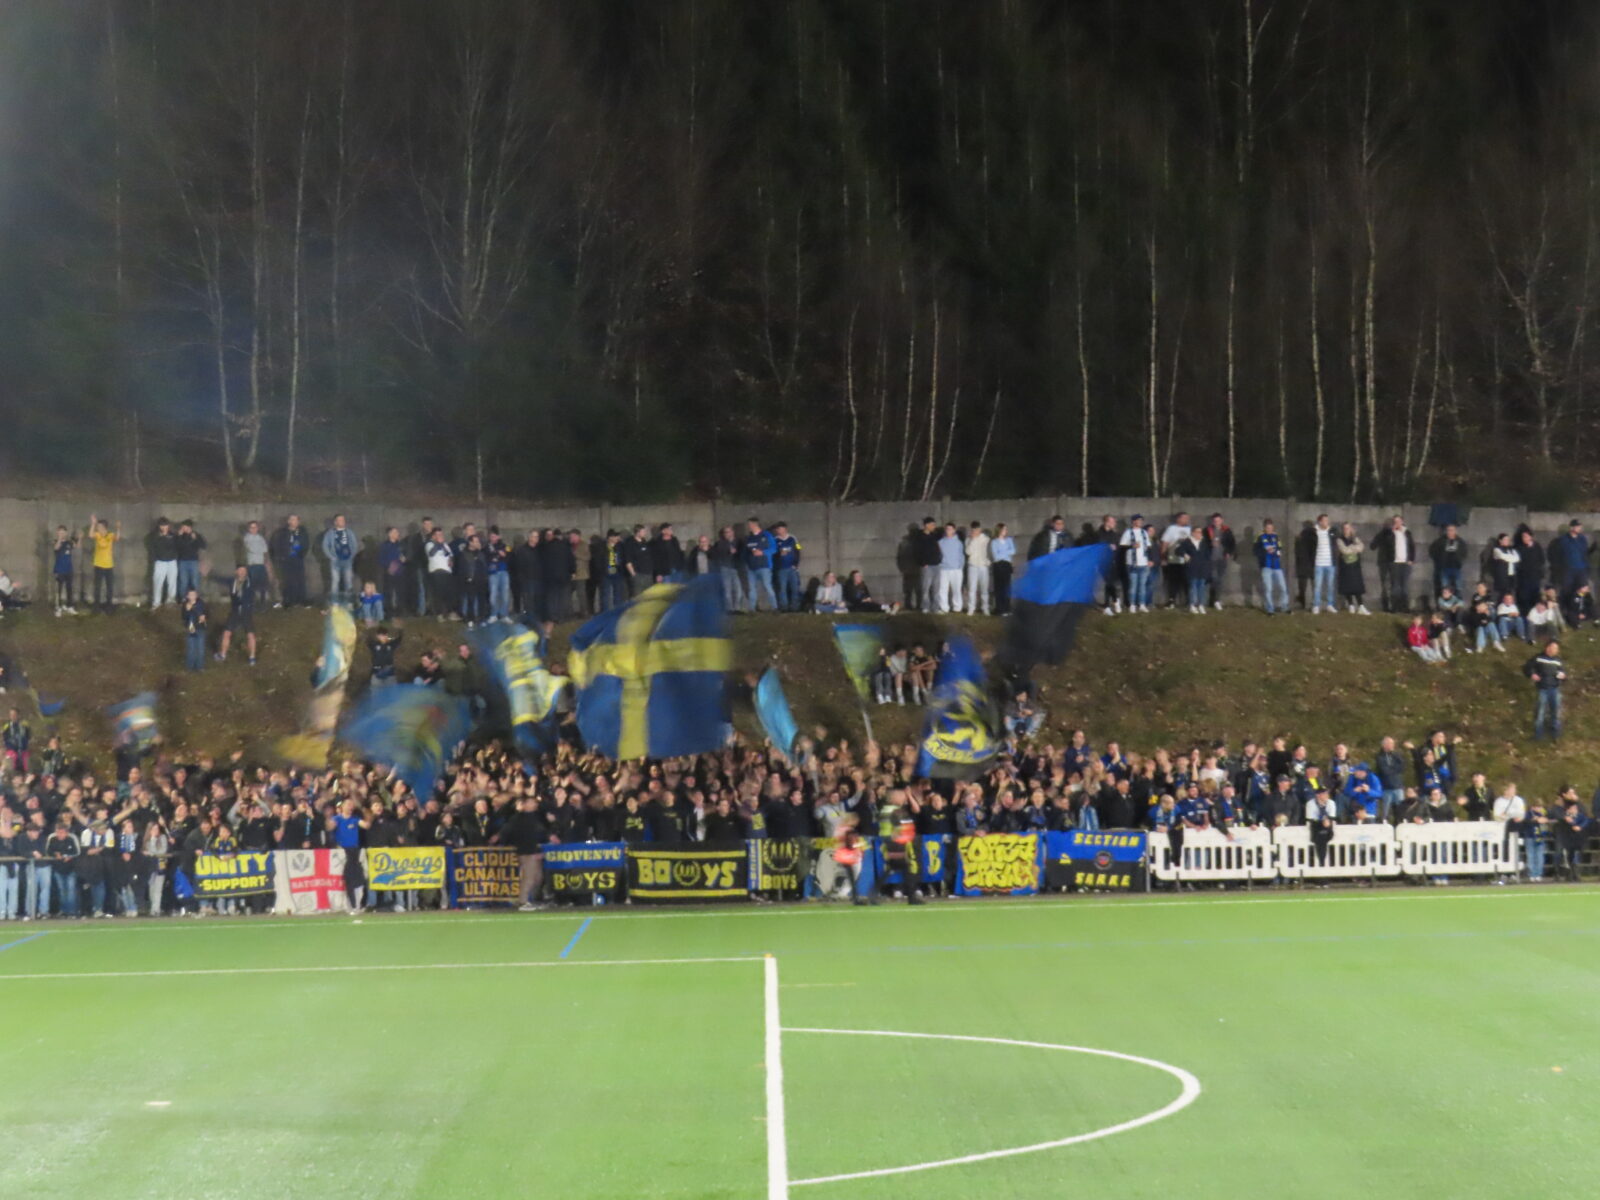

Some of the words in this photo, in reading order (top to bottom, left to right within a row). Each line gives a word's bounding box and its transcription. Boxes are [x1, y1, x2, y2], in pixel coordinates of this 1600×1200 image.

[1074, 832, 1140, 847] SECTION
[464, 852, 519, 867] CLIQUE
[455, 867, 524, 882] CANAILL
[762, 874, 798, 890] BOYS
[464, 881, 520, 896] ULTRAS
